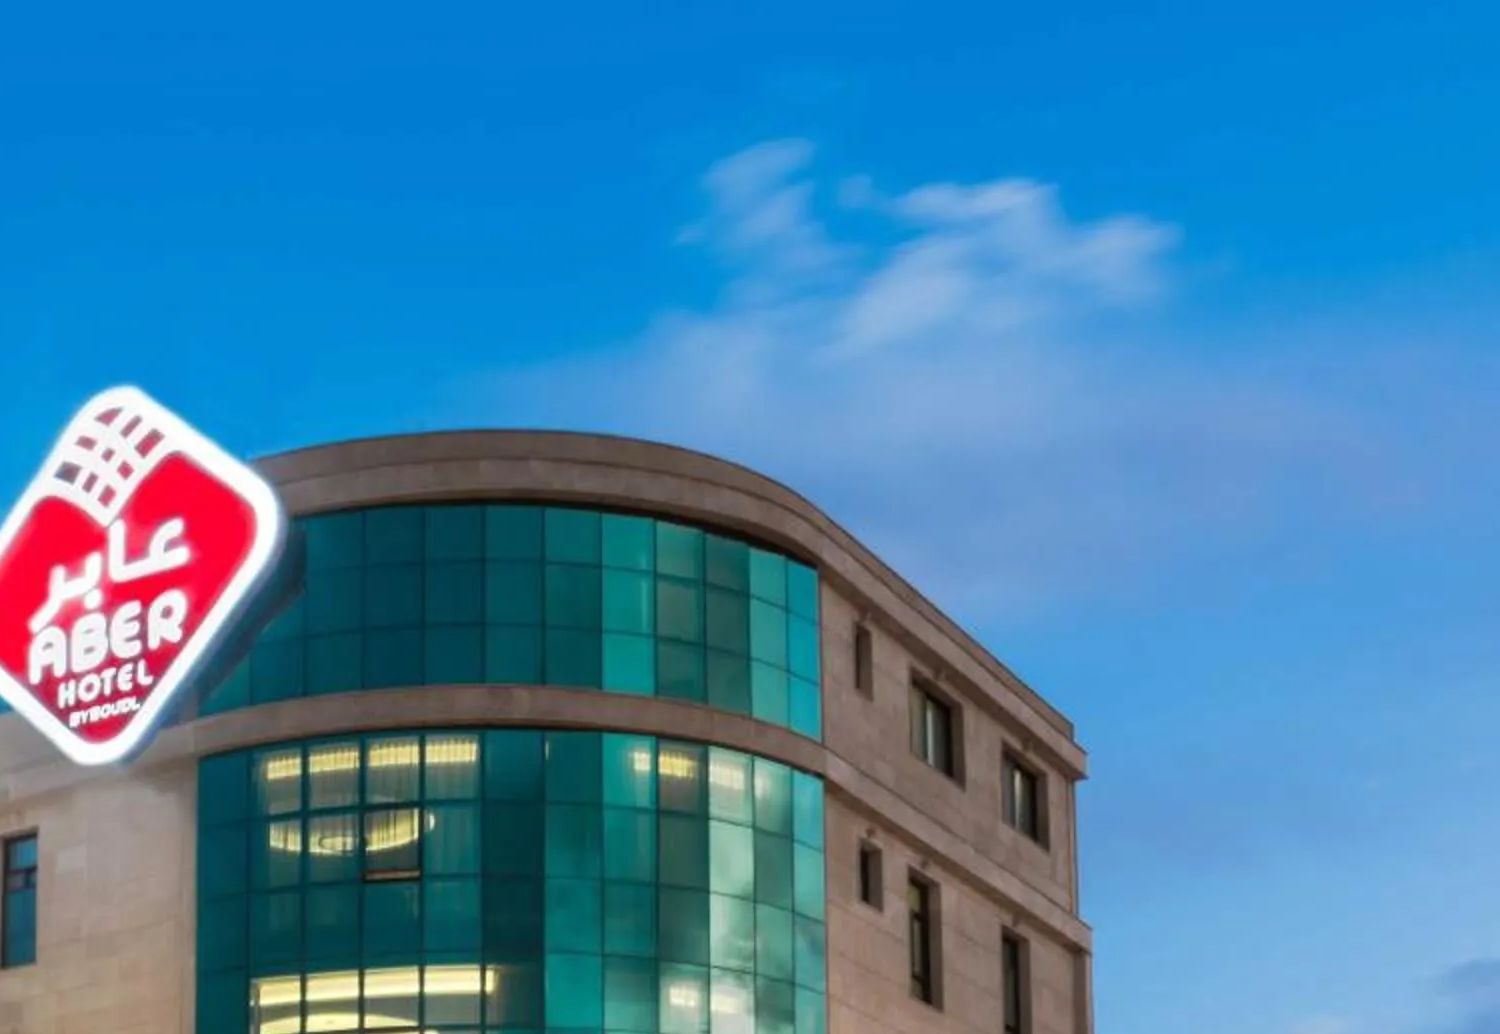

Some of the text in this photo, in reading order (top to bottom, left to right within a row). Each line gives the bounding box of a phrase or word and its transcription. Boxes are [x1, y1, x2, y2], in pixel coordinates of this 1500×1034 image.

[28, 516, 190, 634] عابر
[28, 589, 187, 687] ABER
[57, 659, 154, 709] HOTEL
